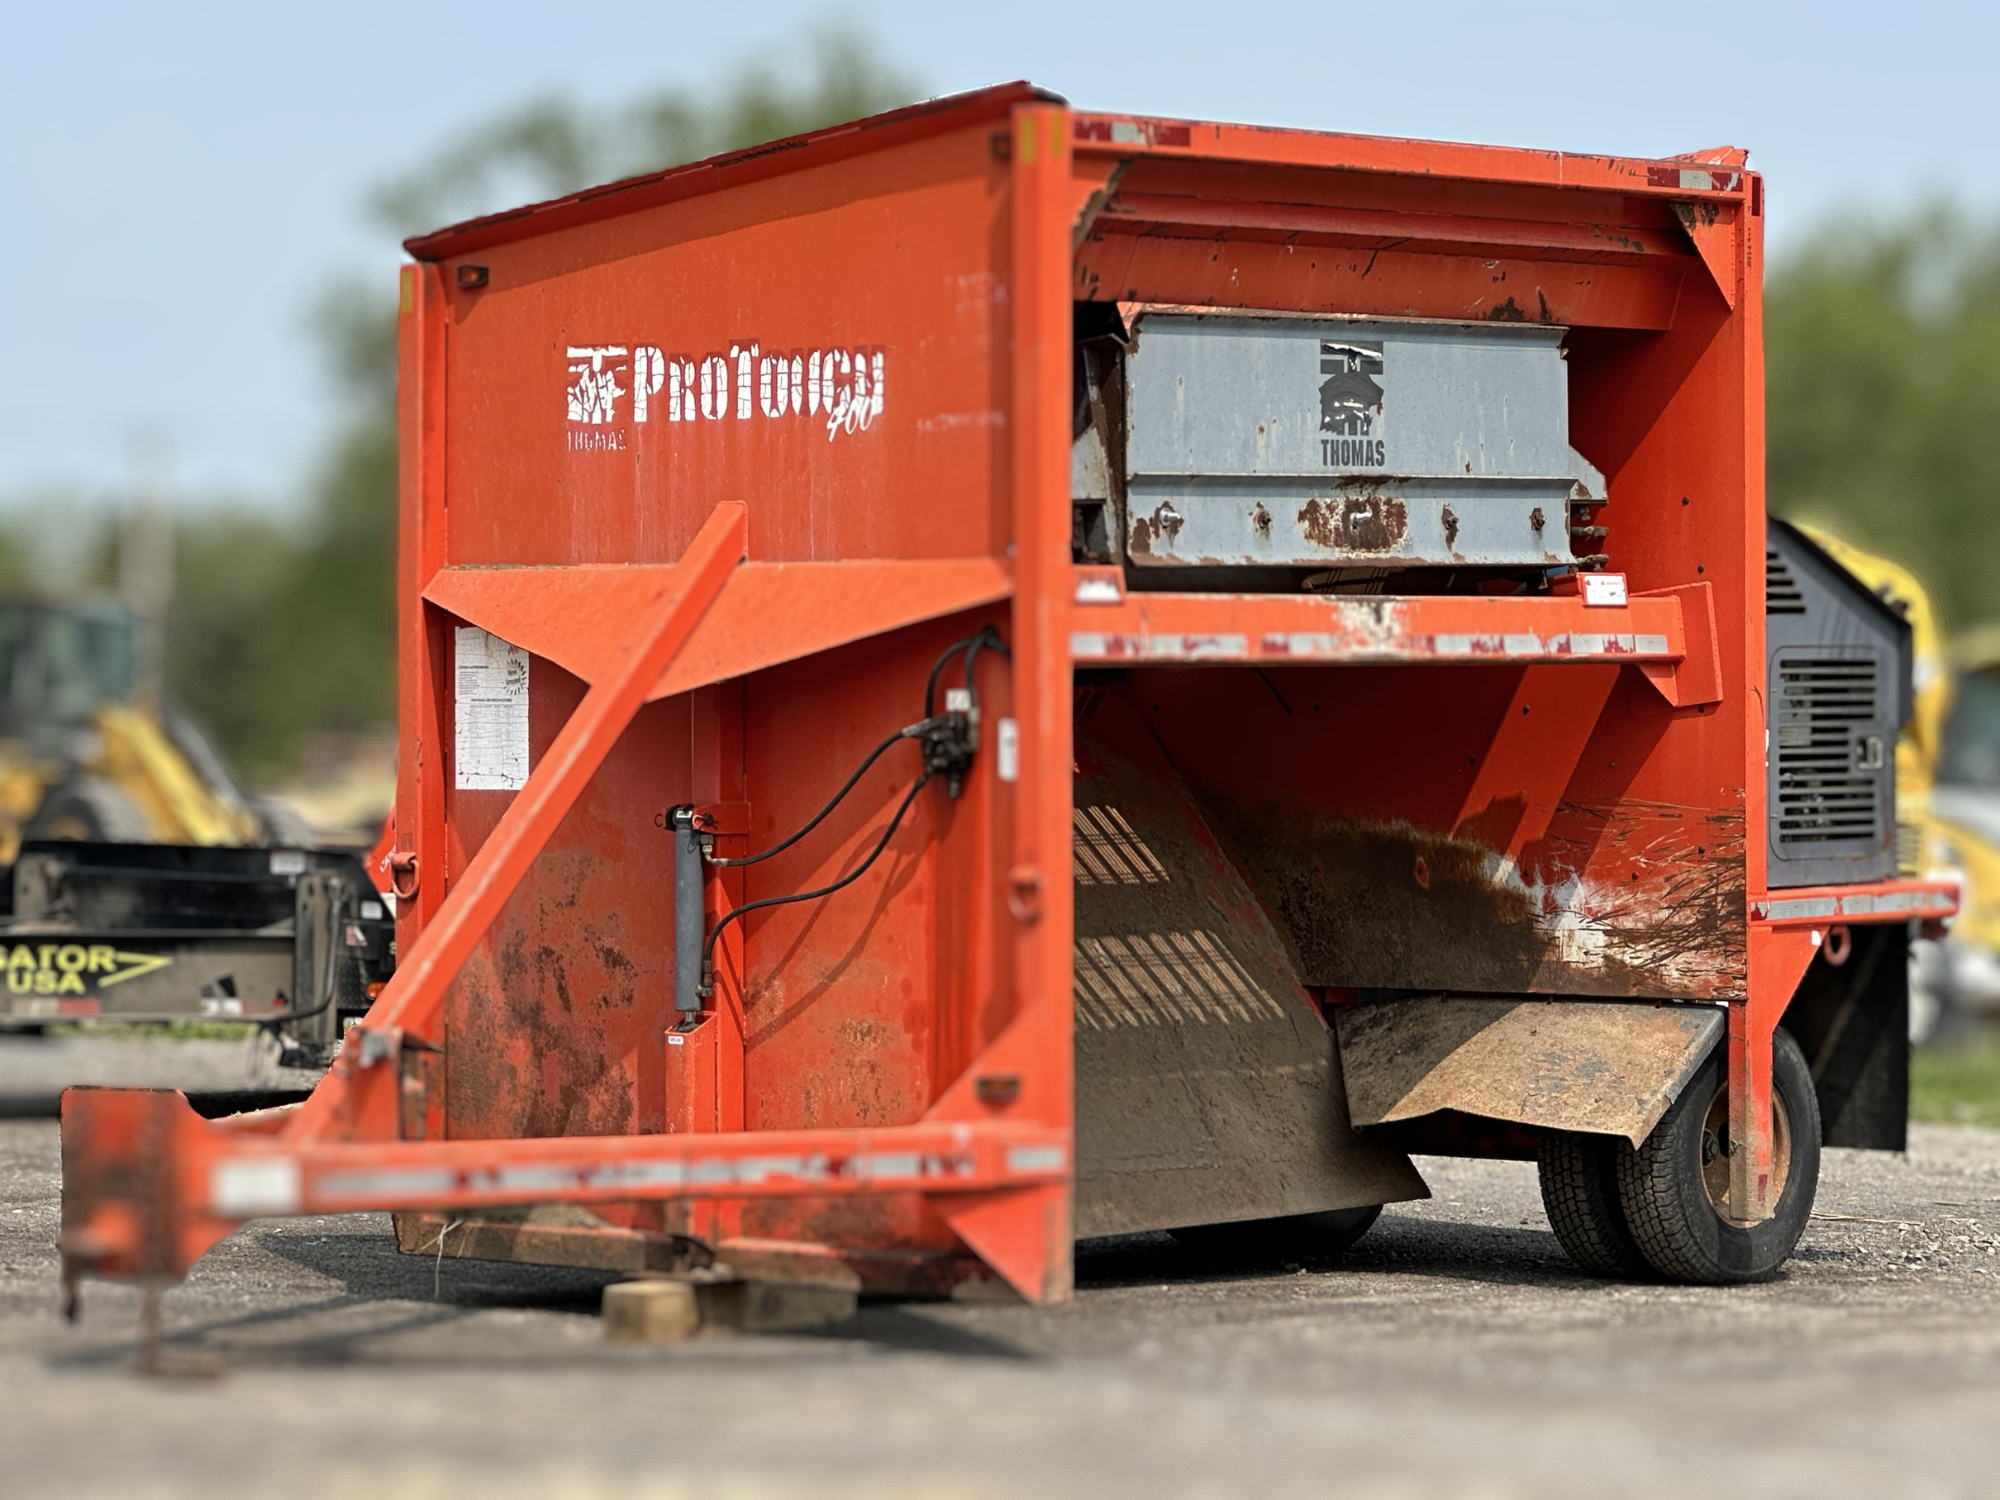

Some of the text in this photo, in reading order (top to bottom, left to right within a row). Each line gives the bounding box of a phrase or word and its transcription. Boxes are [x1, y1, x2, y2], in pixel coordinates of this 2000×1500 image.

[1321, 439, 1385, 467] THOMAS
[0, 943, 117, 973] ATOR
[6, 969, 87, 995] USA
